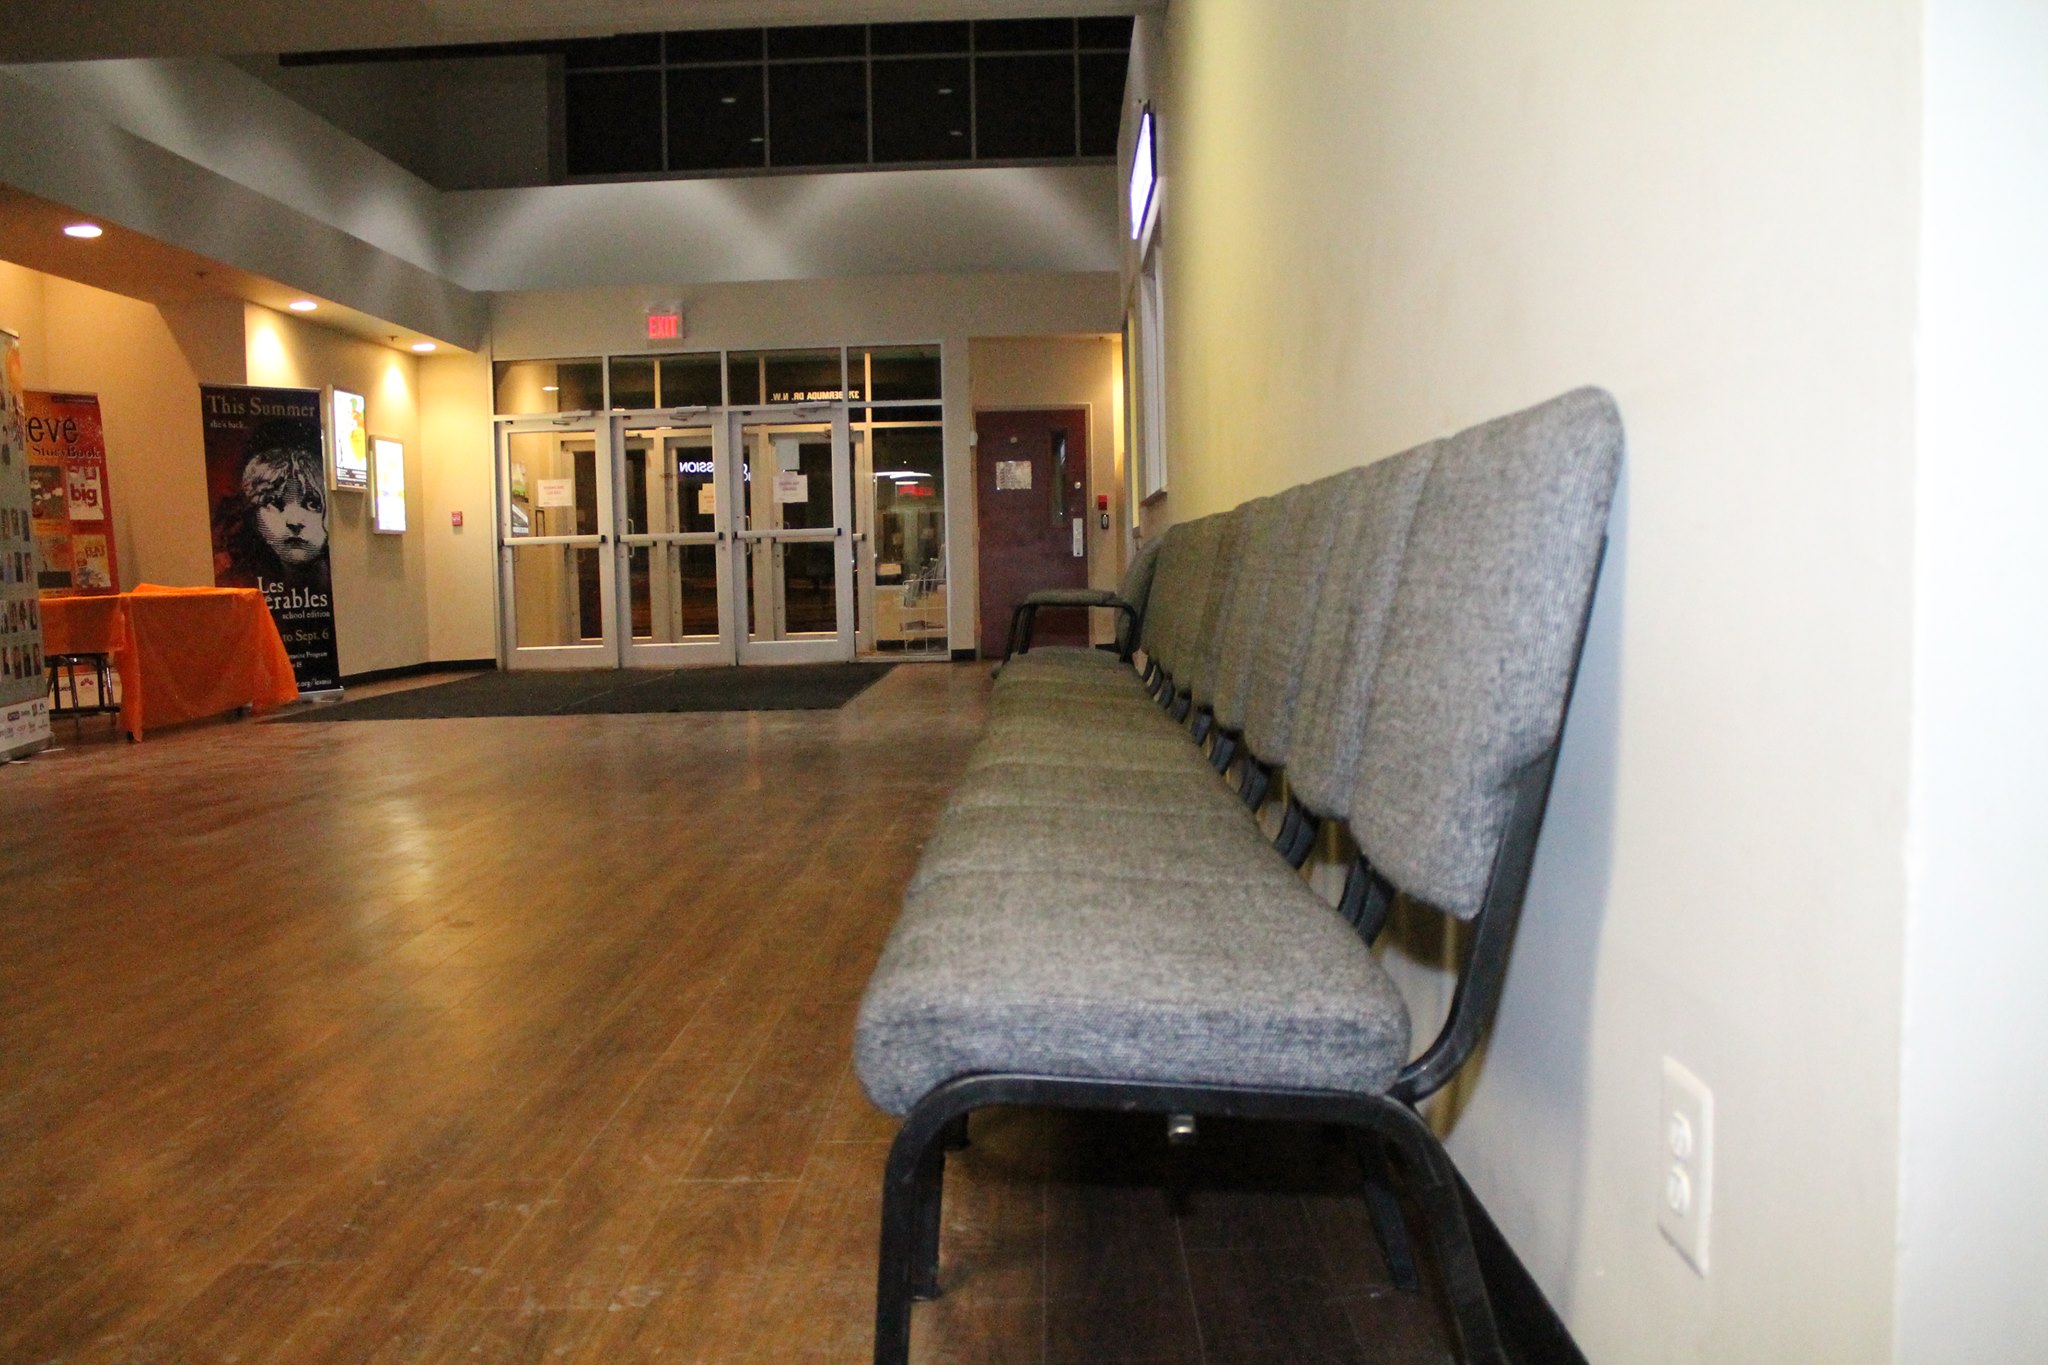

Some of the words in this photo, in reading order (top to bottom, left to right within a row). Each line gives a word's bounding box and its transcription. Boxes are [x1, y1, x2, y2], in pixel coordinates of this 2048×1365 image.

[648, 315, 679, 338] EXIT
[207, 395, 246, 415] This
[250, 397, 315, 417] Summer
[70, 483, 98, 507] big
[257, 576, 284, 594] Les
[282, 610, 305, 620] school
[306, 608, 331, 619] edition
[295, 629, 321, 644] Sept.
[322, 628, 329, 640] 6
